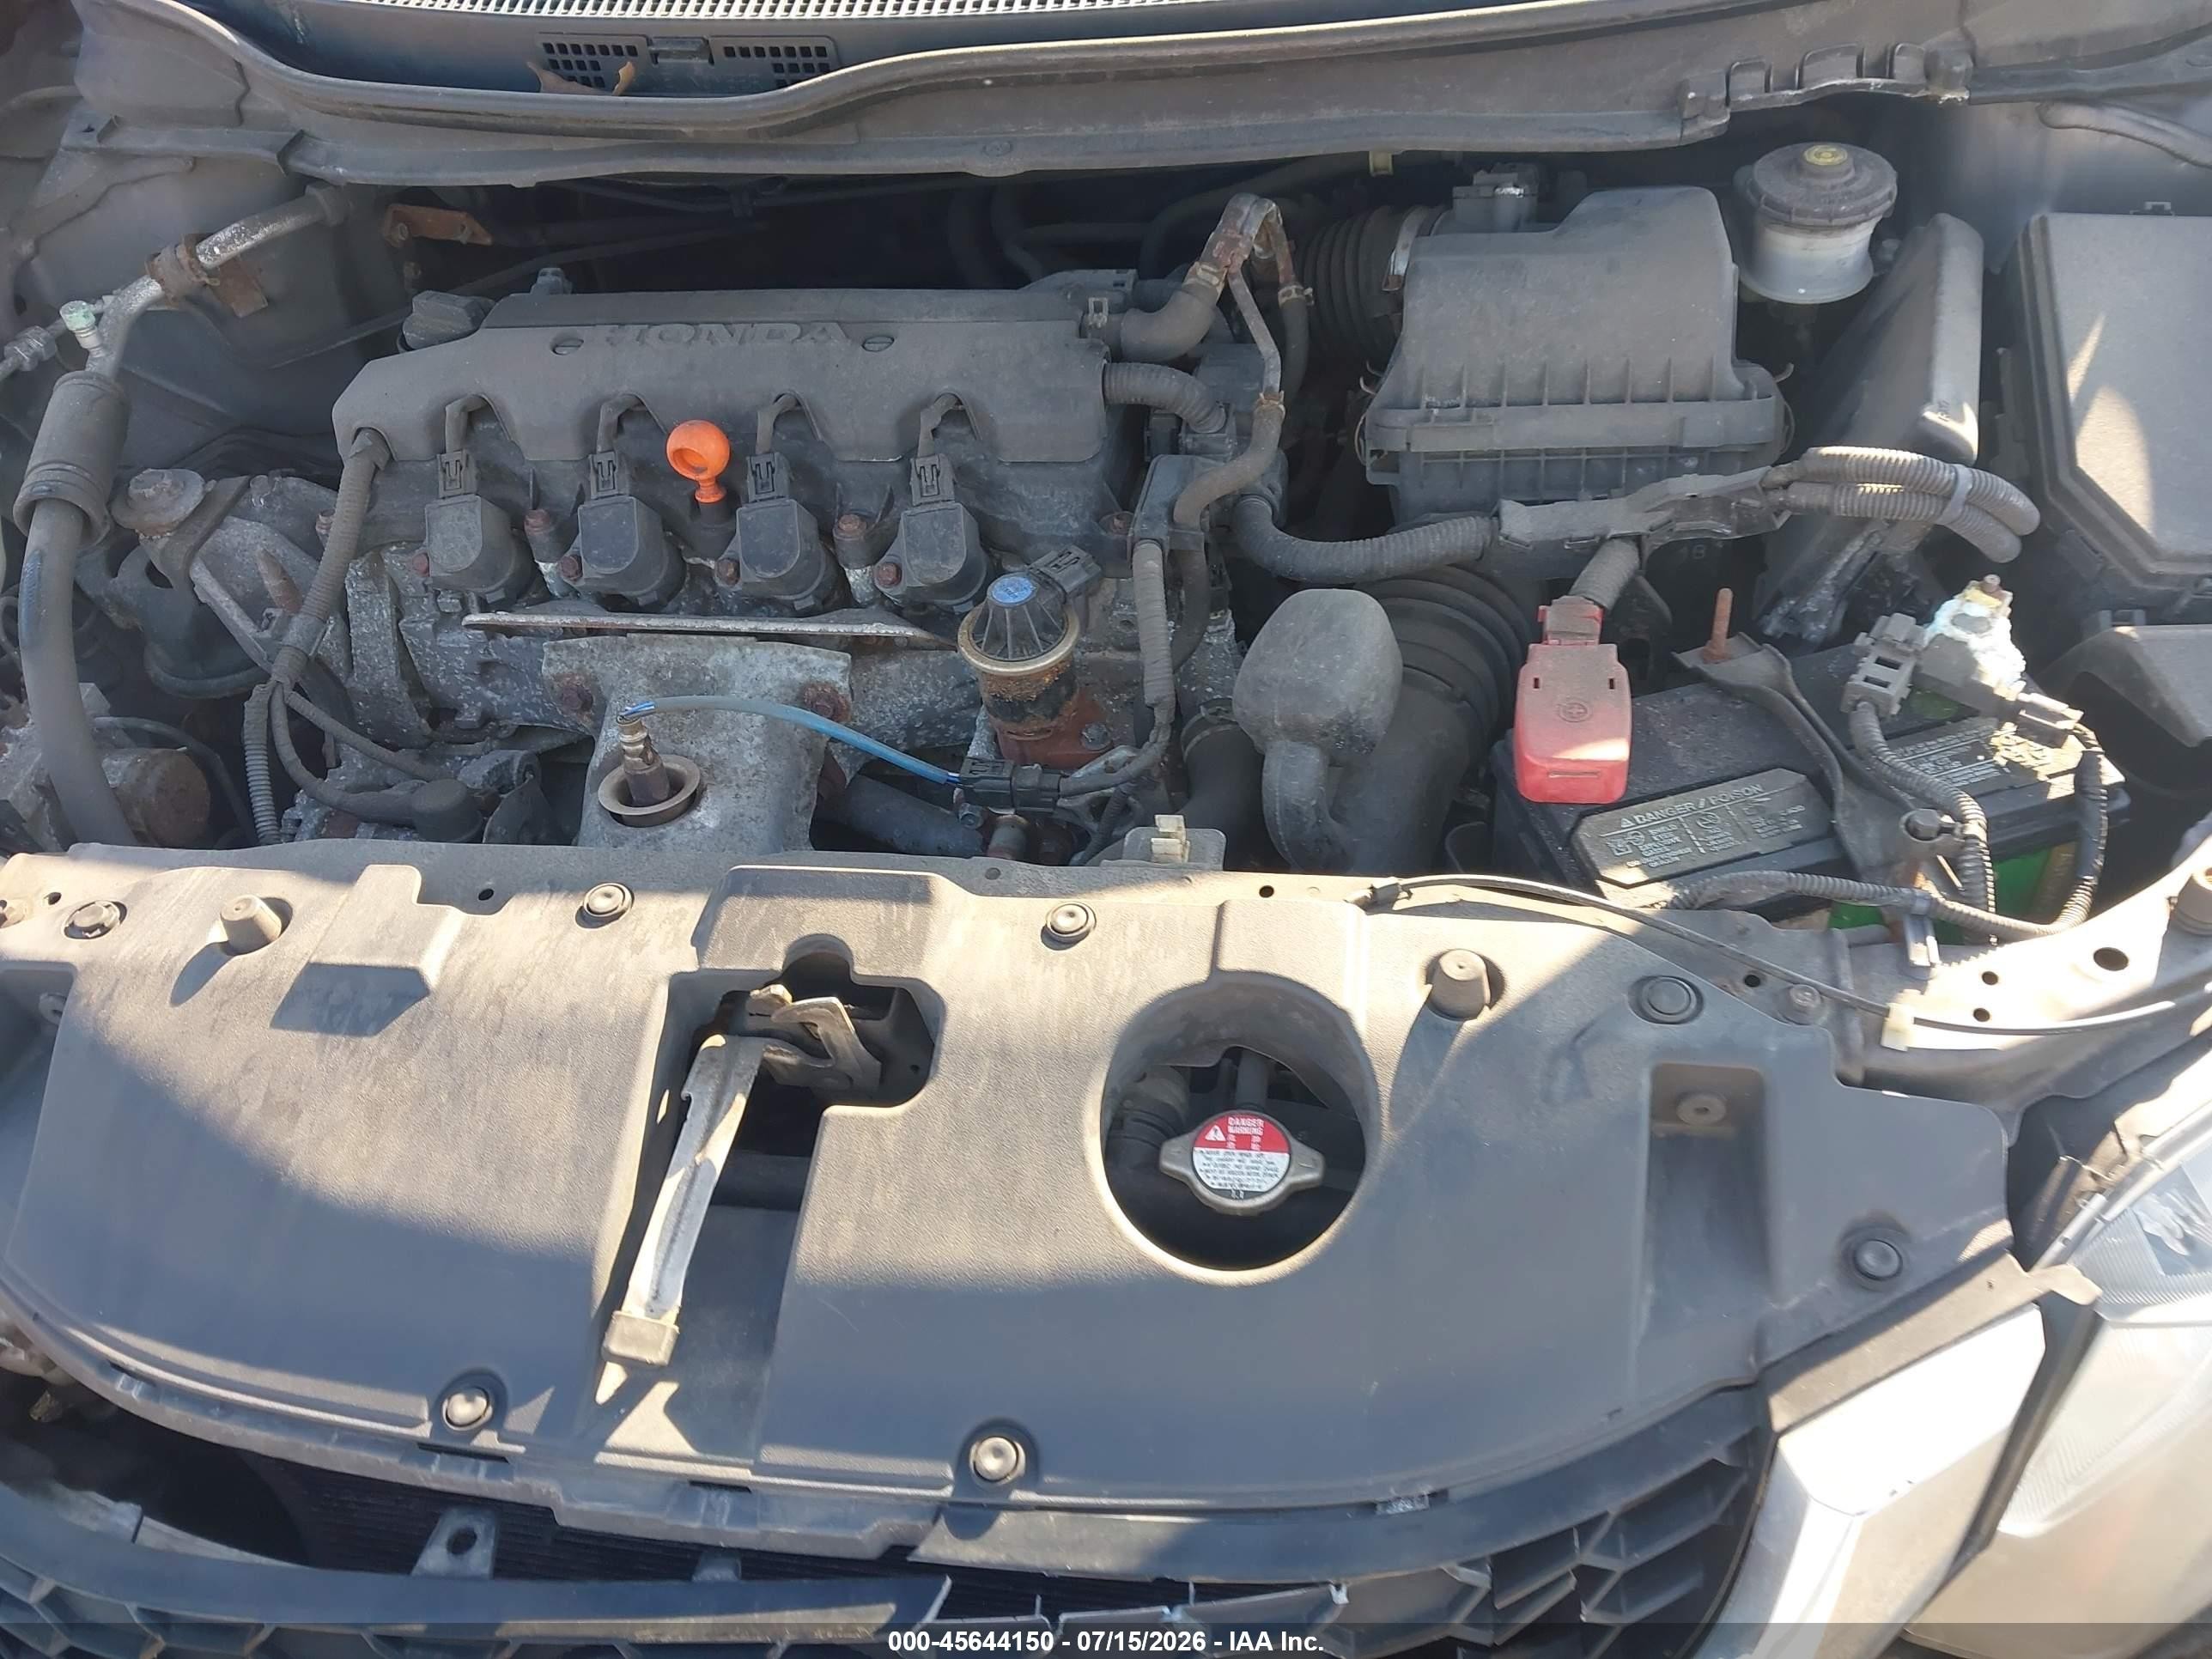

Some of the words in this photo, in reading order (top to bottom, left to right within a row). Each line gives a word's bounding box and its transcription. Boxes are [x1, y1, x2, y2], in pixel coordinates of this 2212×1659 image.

[596, 322, 852, 345] HONDA
[1633, 802, 1697, 824] DANGER
[1709, 784, 1765, 805] POISON
[1228, 1116, 1265, 1127] DANGER
[1228, 1126, 1264, 1136] WARNING
